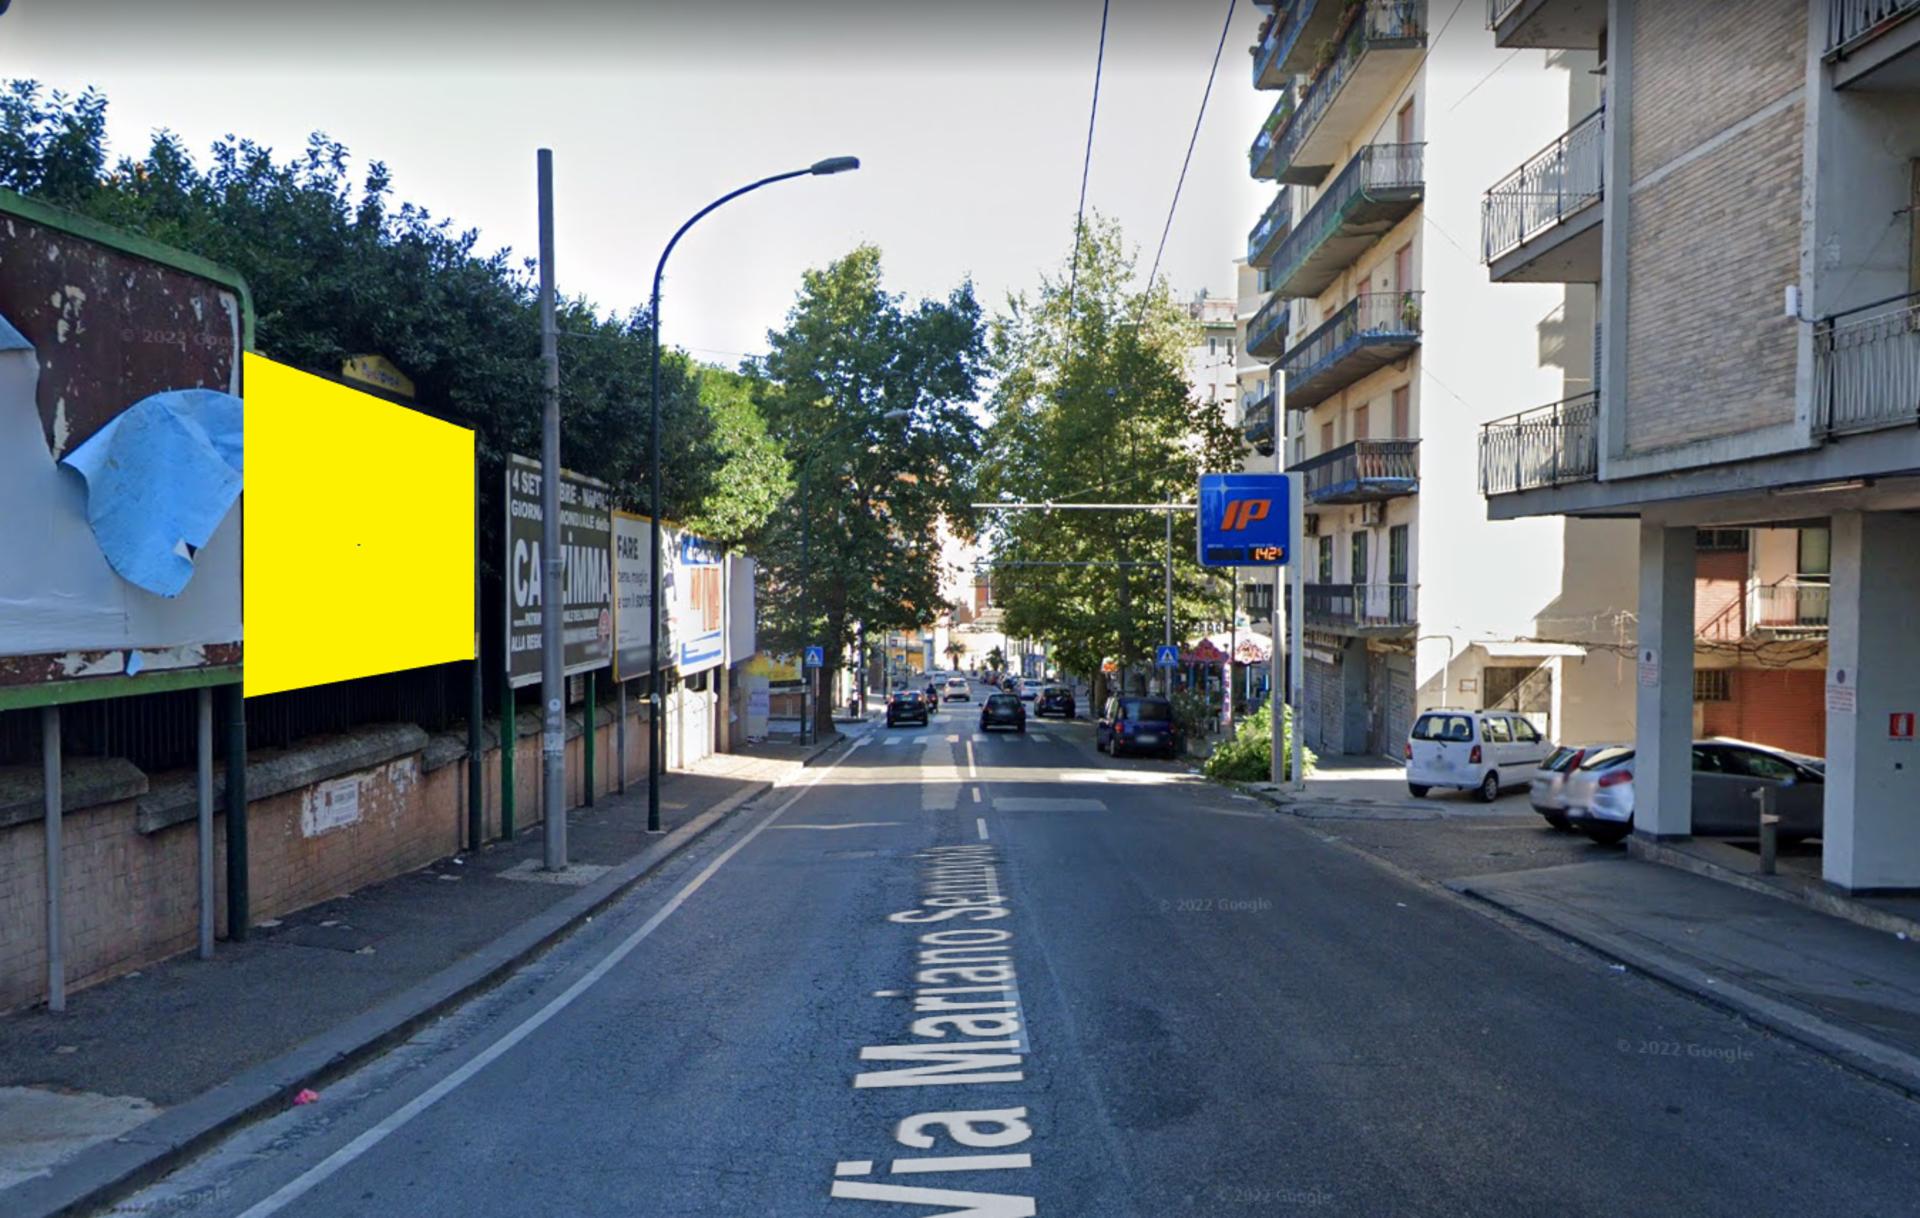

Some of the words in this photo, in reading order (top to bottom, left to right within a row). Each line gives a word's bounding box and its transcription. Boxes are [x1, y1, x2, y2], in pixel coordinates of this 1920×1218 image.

[512, 469, 520, 492] 4
[1220, 498, 1272, 531] IP
[617, 535, 639, 560] FARE
